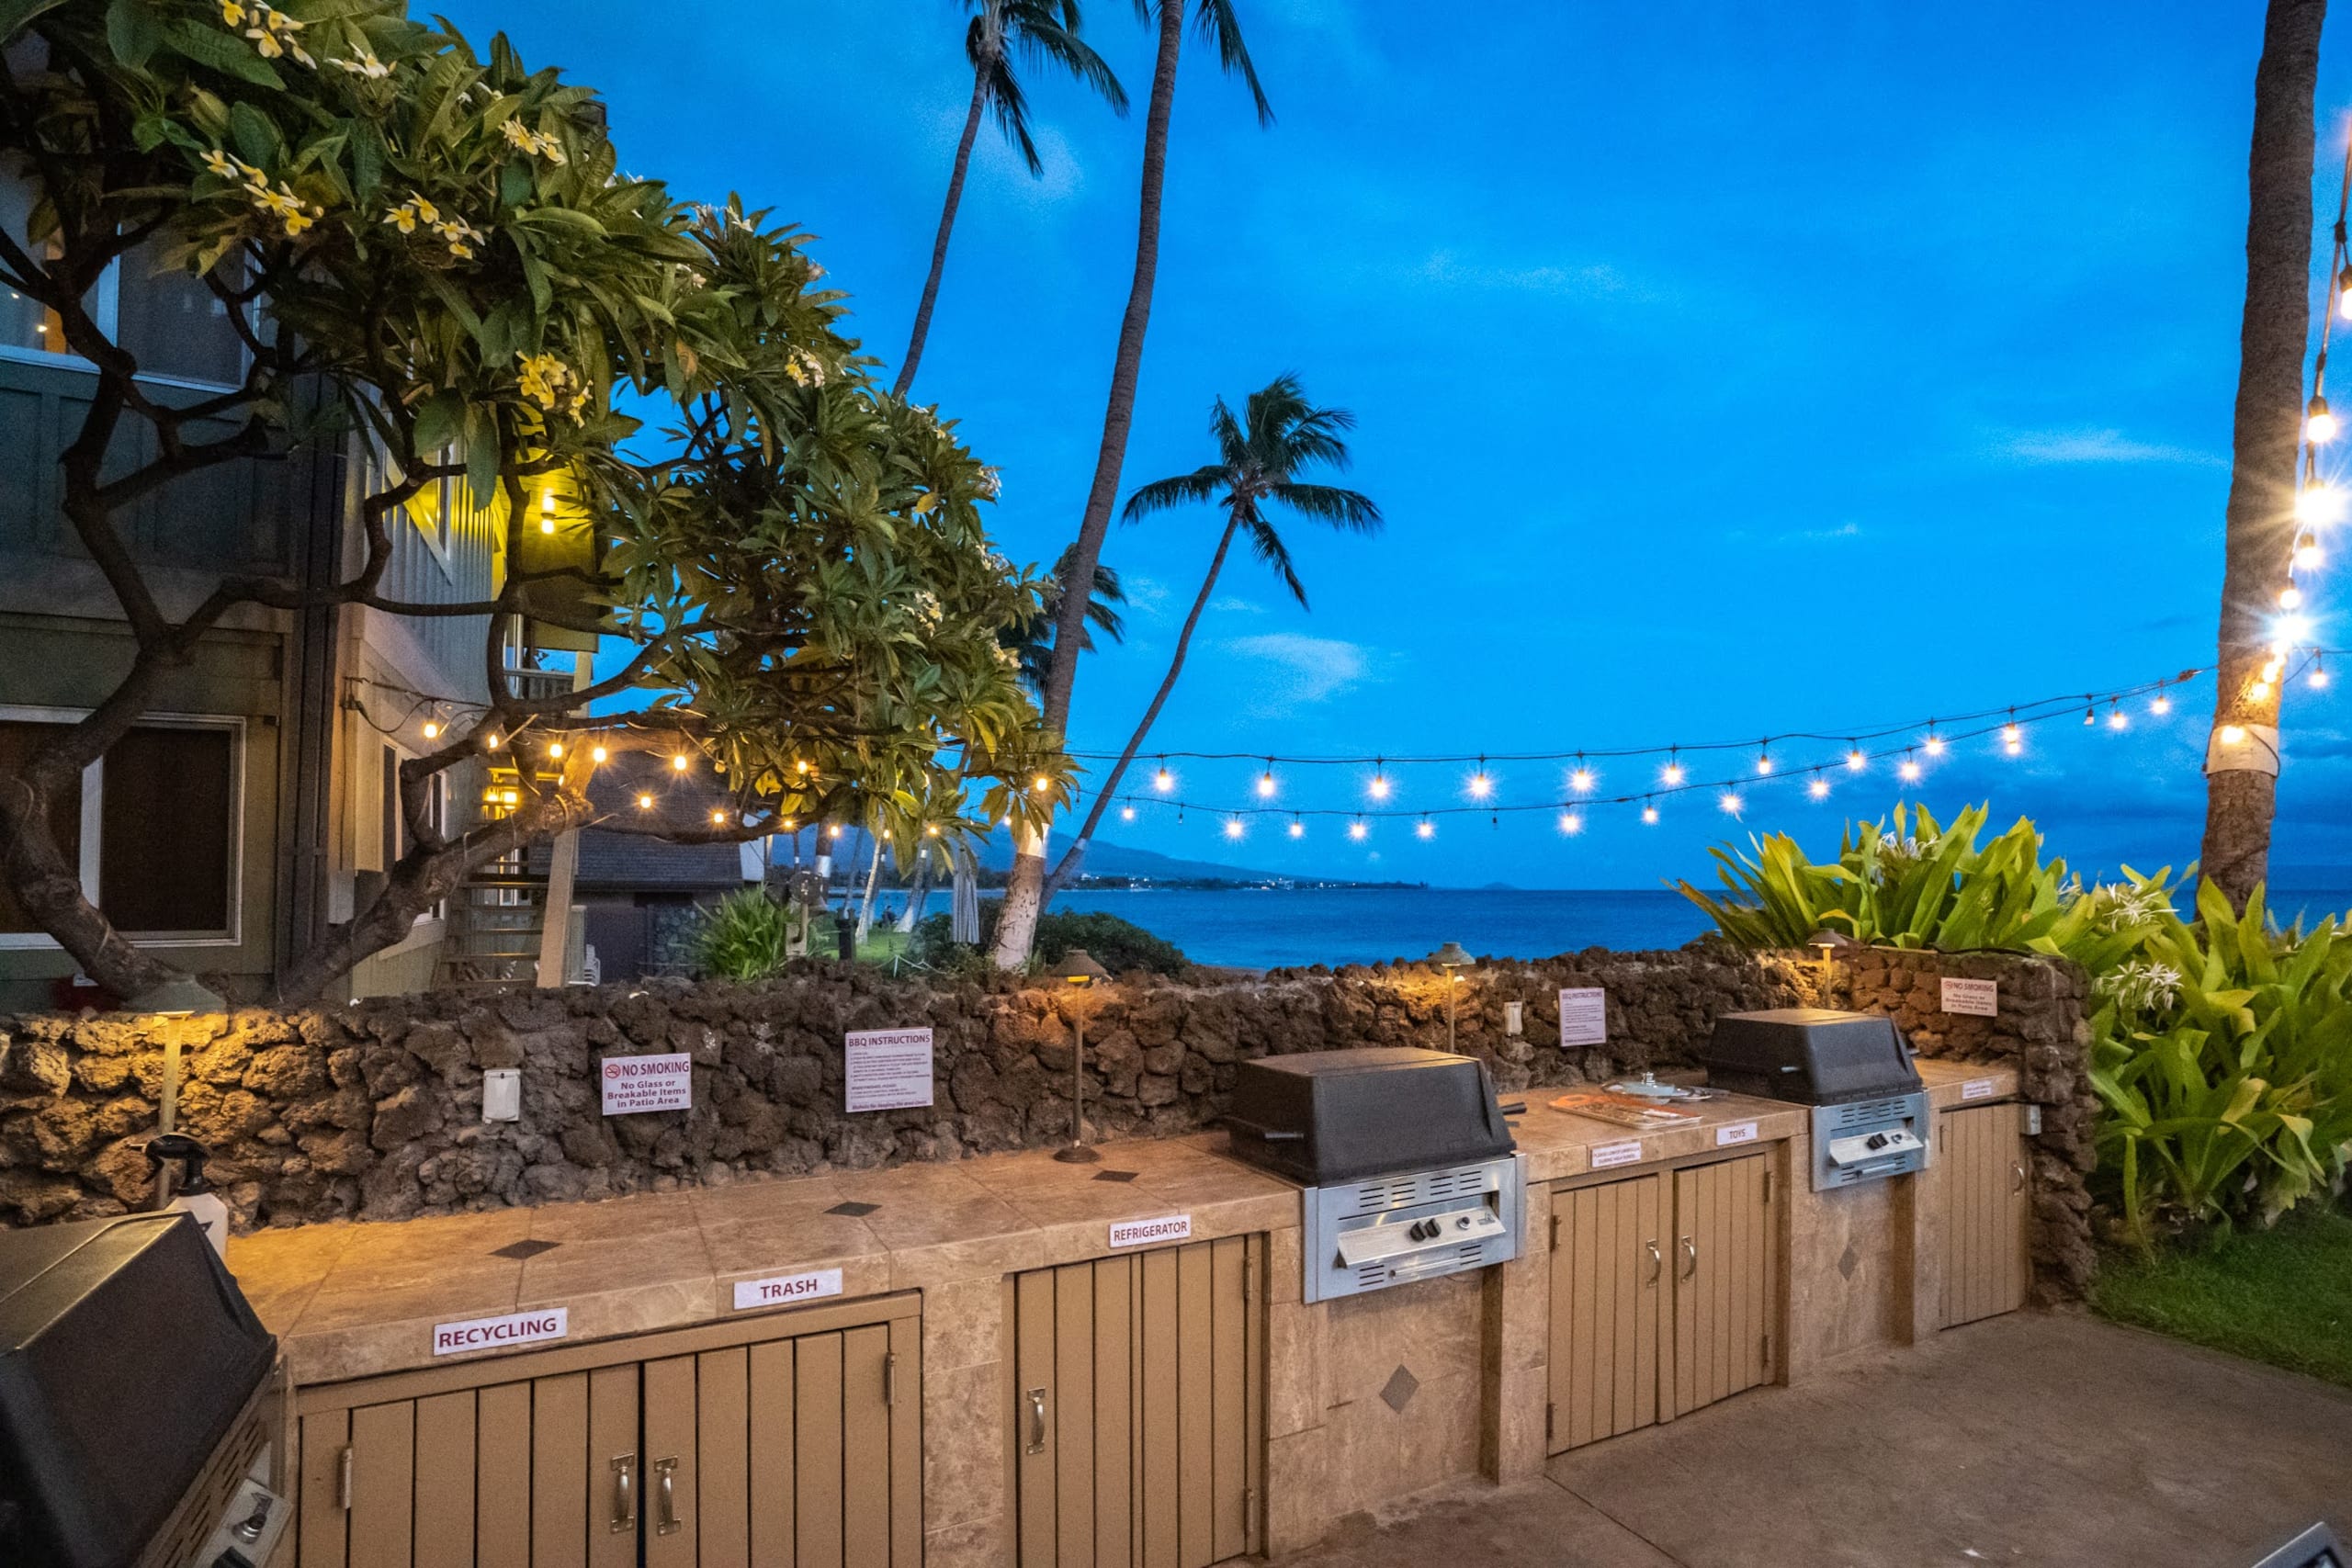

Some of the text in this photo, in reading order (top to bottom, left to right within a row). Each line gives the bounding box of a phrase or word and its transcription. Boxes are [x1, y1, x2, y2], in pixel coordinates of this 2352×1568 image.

[1953, 982, 1994, 992] NO SMOKING
[848, 1035, 930, 1047] BBQ INSTRUCTIONS
[622, 1061, 689, 1077] NO SMOKING
[637, 1079, 663, 1089] Glass
[607, 1088, 686, 1100] Breakable Items
[617, 1097, 680, 1109] in Patio Area
[1729, 1128, 1746, 1139] TOYS
[1114, 1221, 1188, 1242] REFRIGERATOR
[760, 1278, 819, 1300] TRASH
[438, 1316, 558, 1348] RECYCLING
